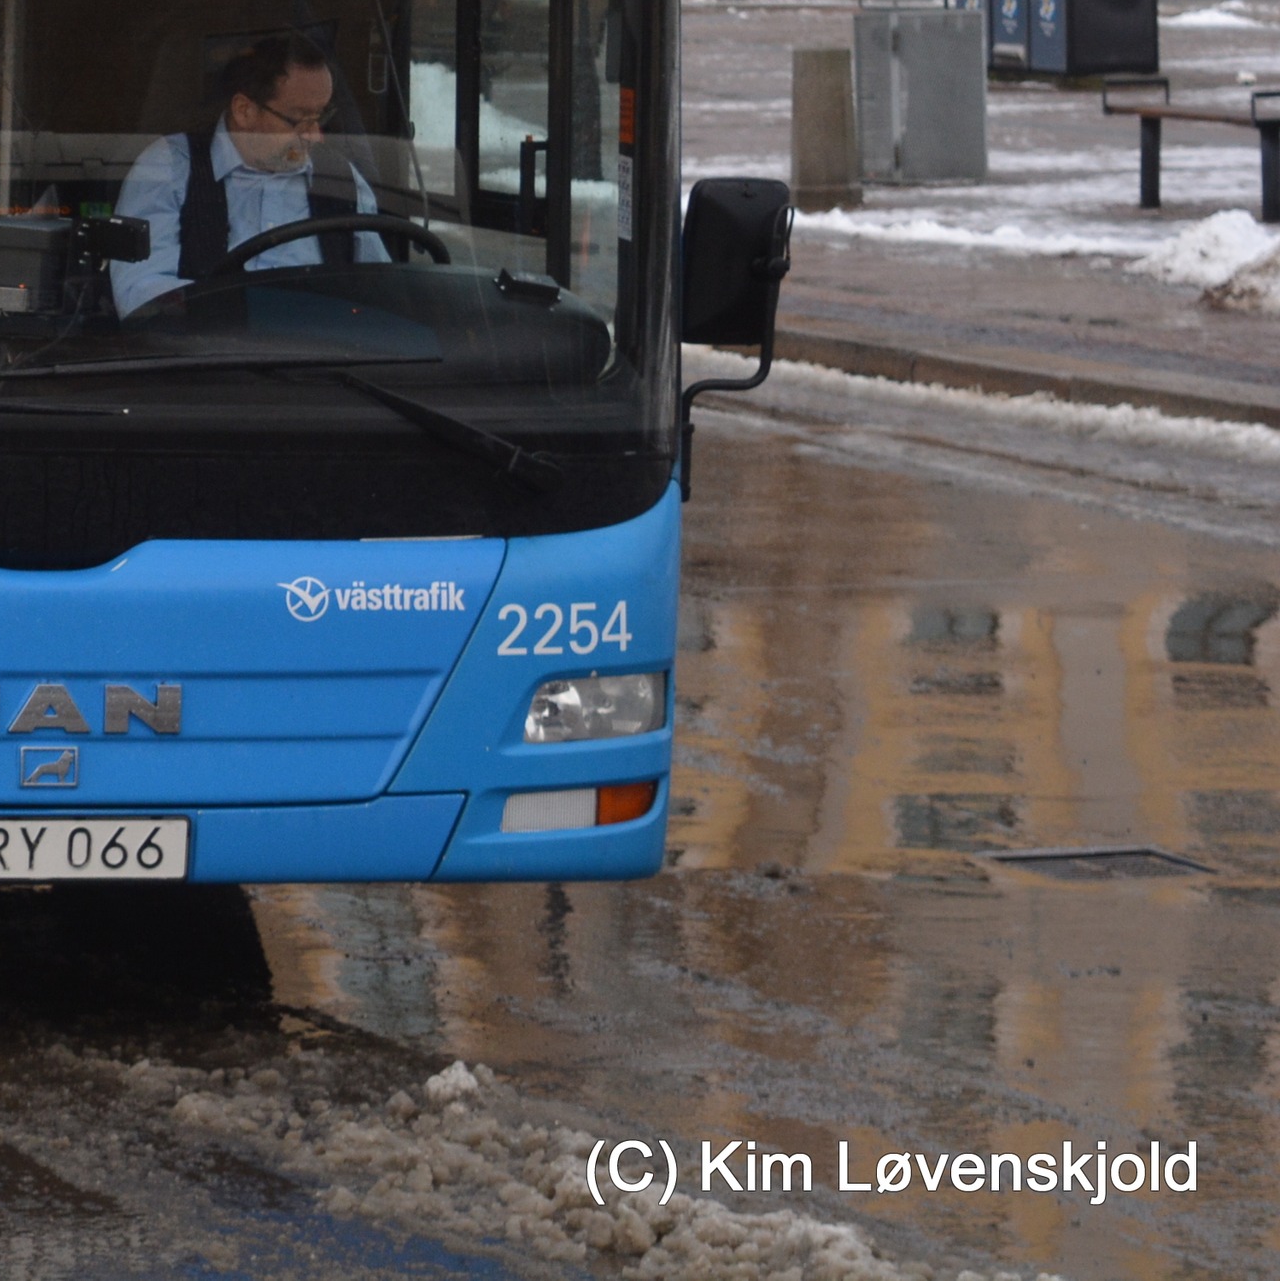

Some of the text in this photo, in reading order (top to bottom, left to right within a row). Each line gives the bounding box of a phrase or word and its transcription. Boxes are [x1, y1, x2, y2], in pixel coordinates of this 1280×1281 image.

[335, 581, 465, 612] västtrafik
[497, 600, 633, 656] 2254
[67, 826, 164, 870] 066
